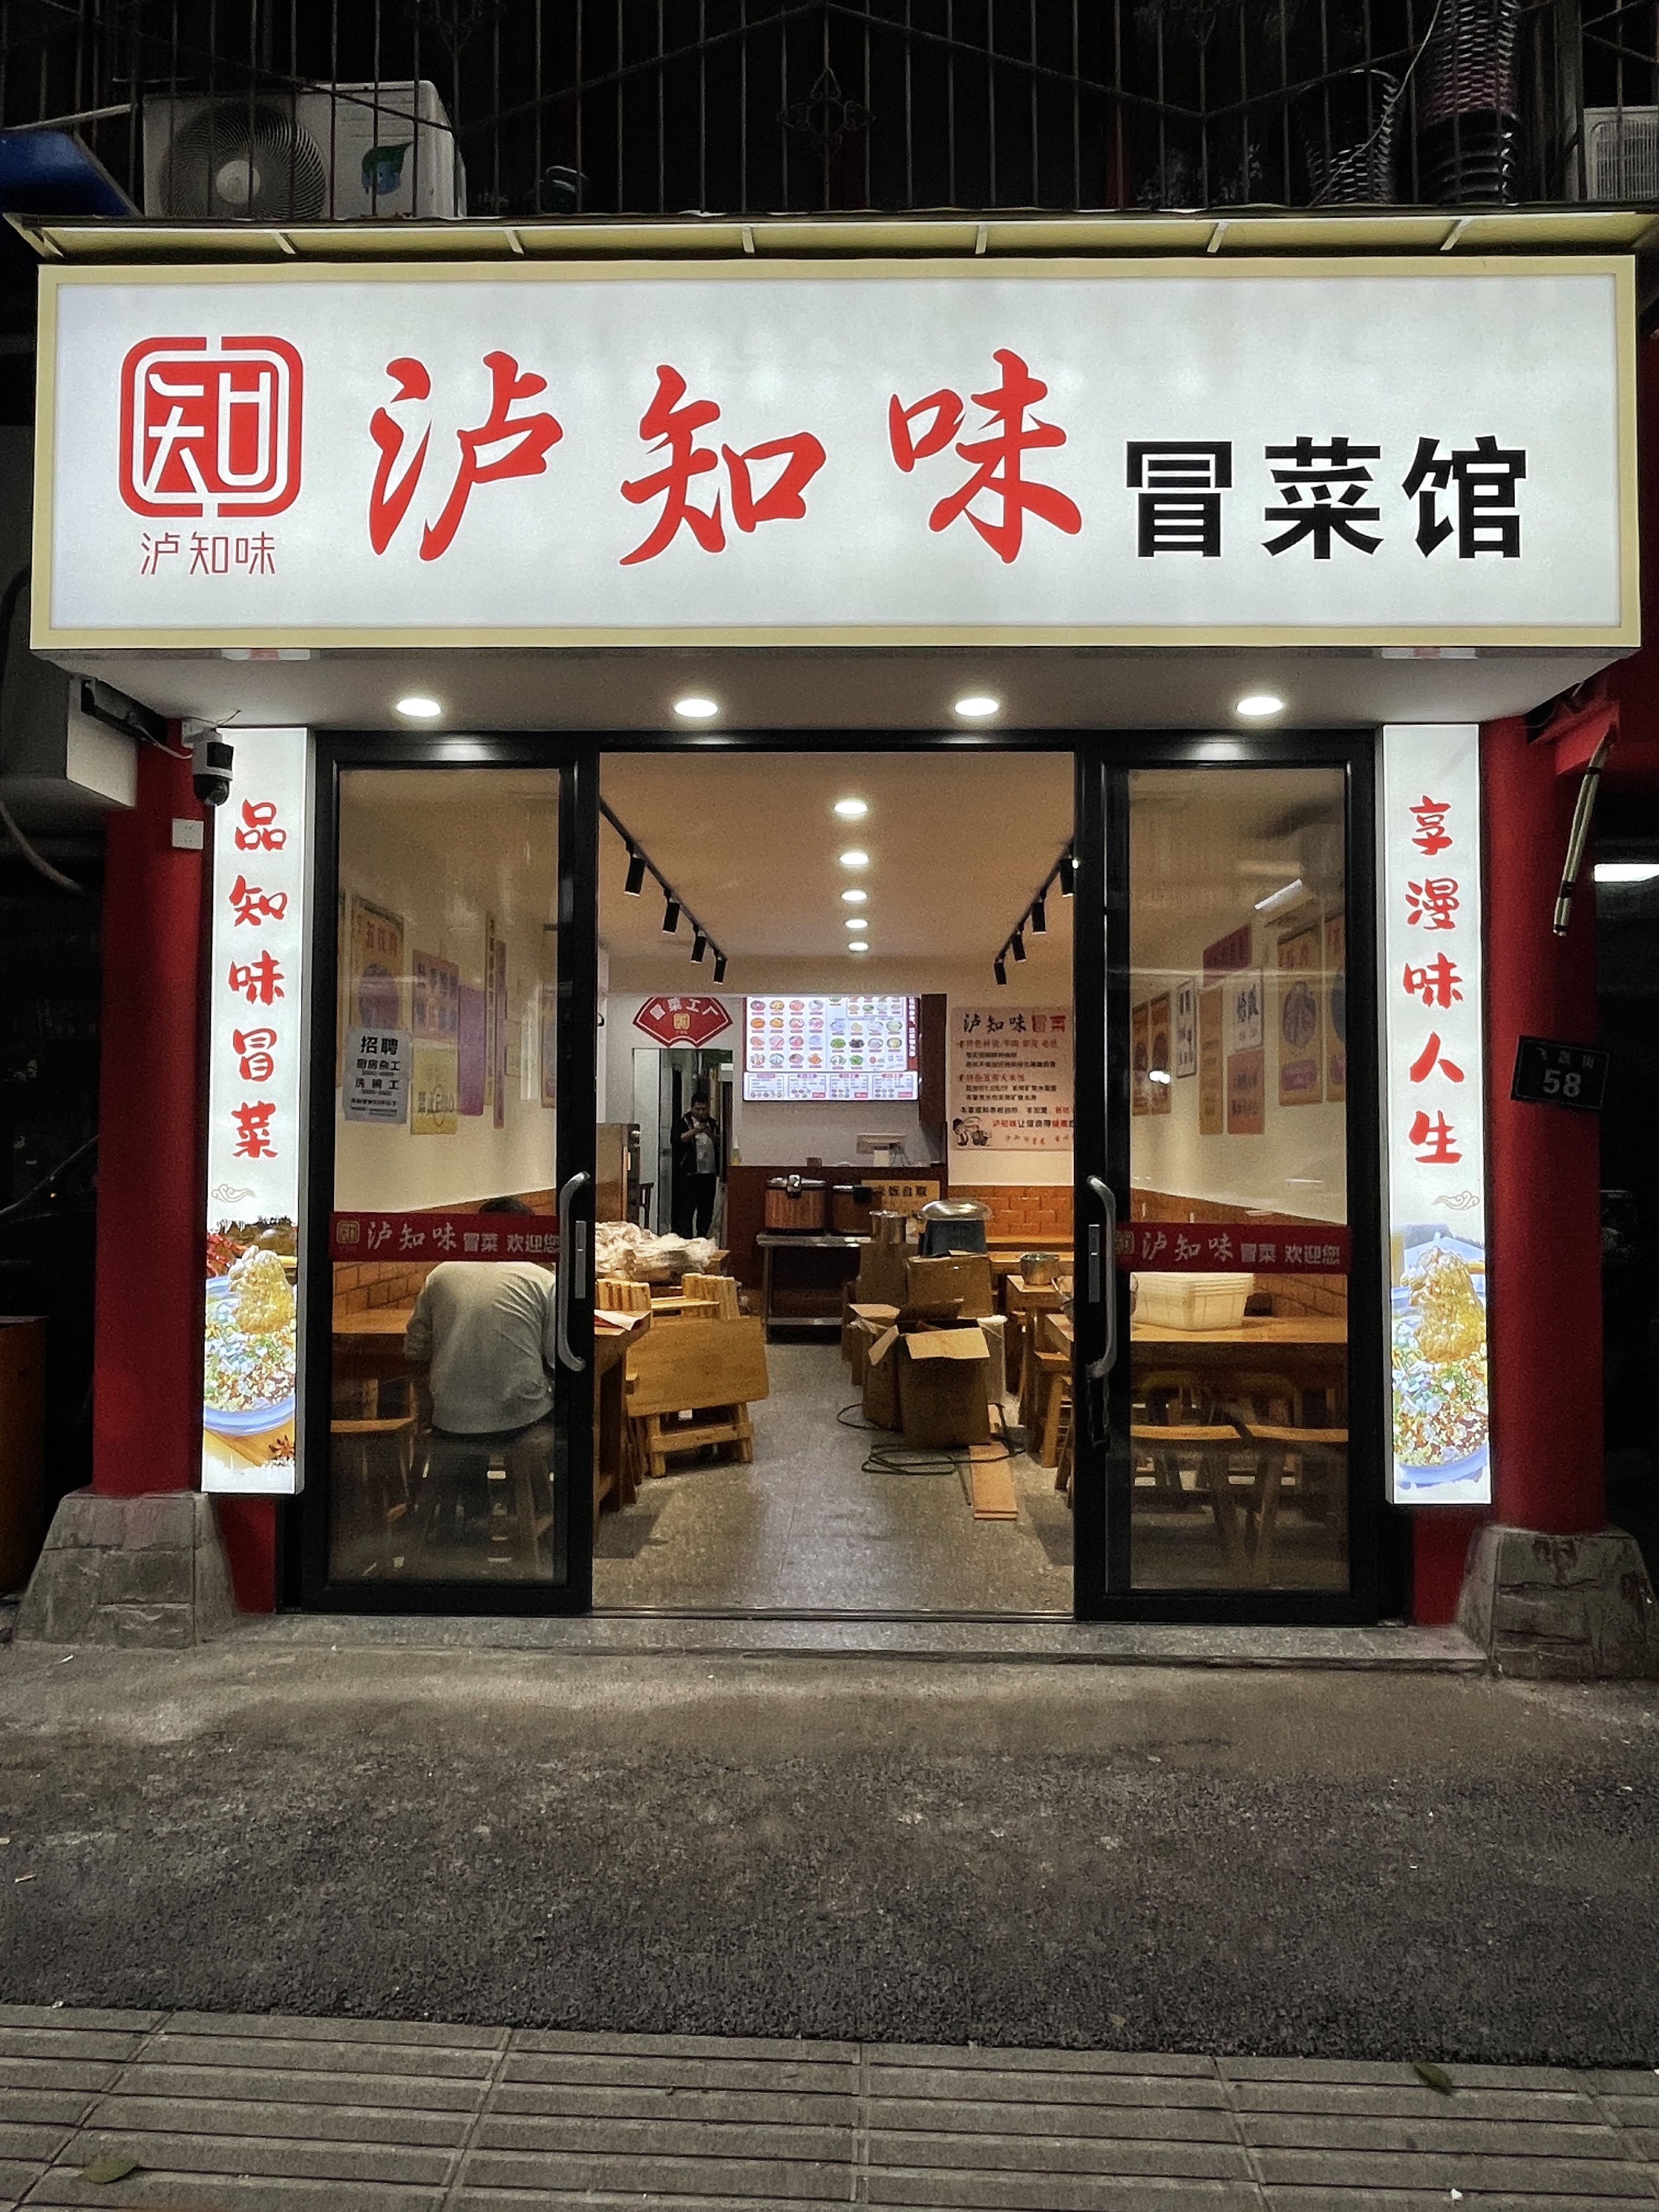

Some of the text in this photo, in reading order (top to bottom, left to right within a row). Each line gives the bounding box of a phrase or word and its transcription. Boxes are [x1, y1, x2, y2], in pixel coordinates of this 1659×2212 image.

[369, 348, 1527, 566] 泸知味 冒菜馆
[141, 533, 275, 574] 泸知味
[229, 799, 288, 1159] 品知味冒菜
[1403, 795, 1465, 1164] 享漫味人生
[360, 1036, 398, 1055] 招聘
[1543, 1068, 1581, 1098] 58
[368, 1221, 456, 1251] 泸知味
[1142, 1230, 1233, 1262] 泸知味
